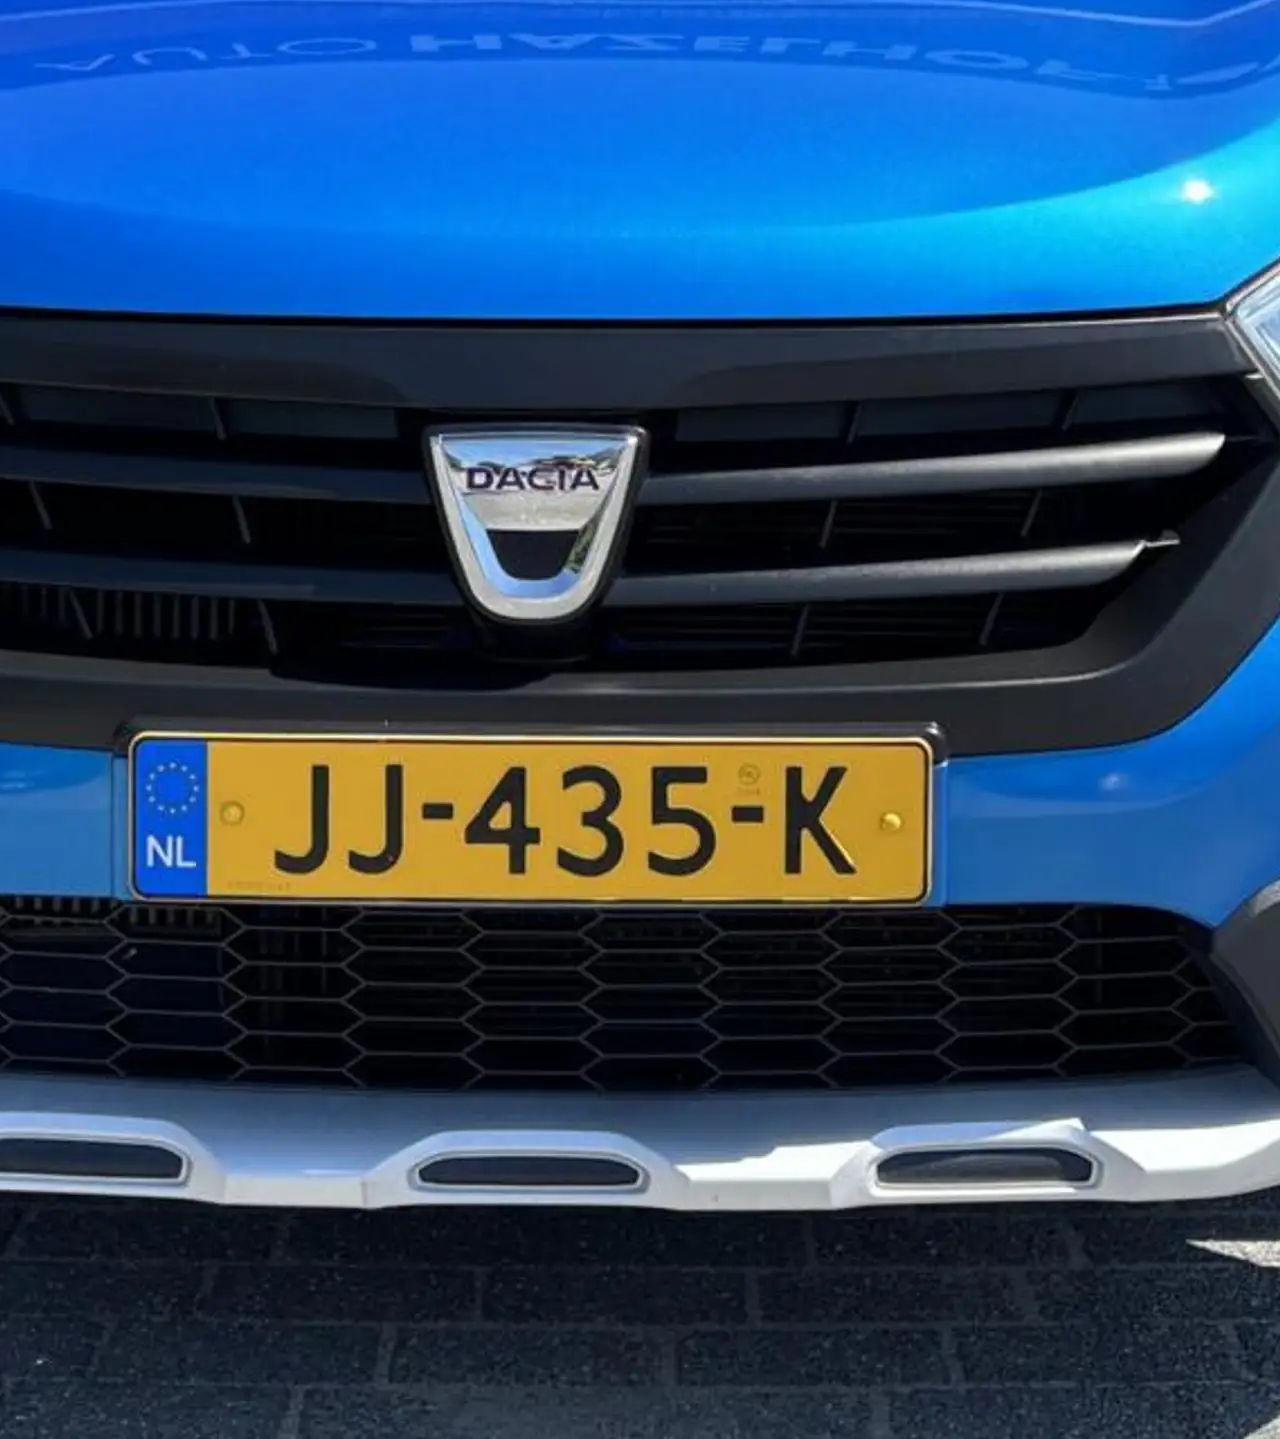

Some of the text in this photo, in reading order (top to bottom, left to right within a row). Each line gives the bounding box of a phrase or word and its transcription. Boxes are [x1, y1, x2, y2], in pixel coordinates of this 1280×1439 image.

[465, 465, 601, 493] DACIA
[273, 763, 857, 877] JJ-435-K
[145, 835, 197, 869] NL
